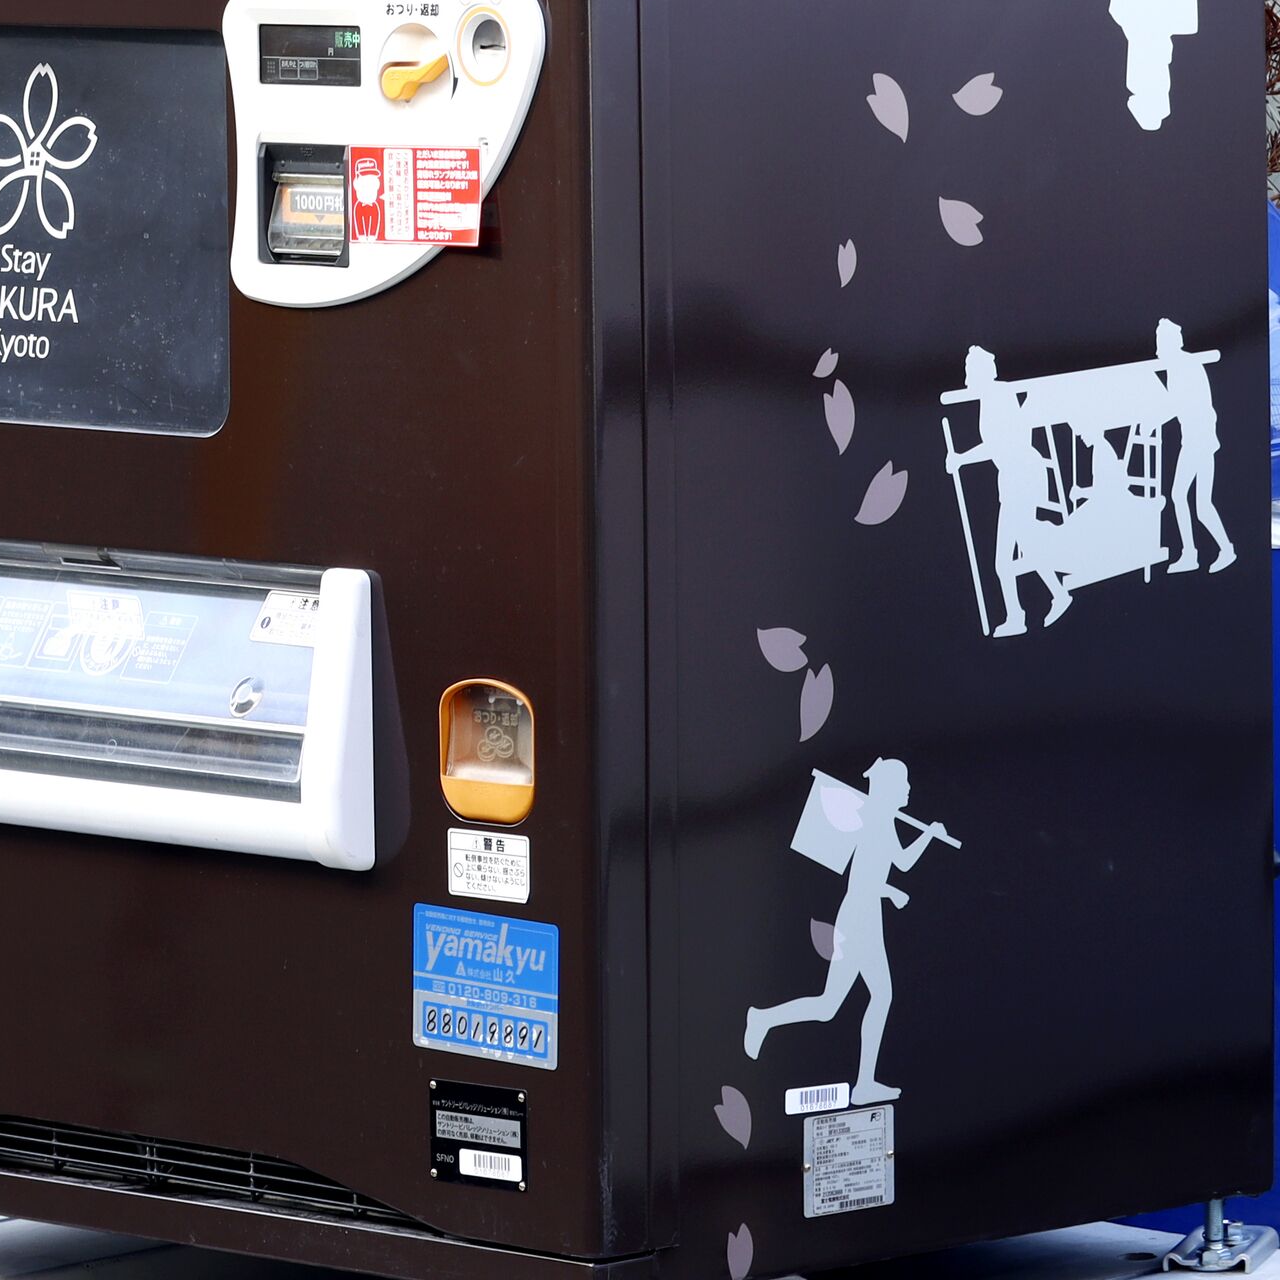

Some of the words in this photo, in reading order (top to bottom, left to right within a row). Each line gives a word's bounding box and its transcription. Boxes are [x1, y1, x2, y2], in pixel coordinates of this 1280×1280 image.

[386, 3, 440, 16] おつり・返却
[334, 31, 360, 48] 販売中
[0, 243, 52, 281] Stay
[483, 837, 506, 852] 警告
[425, 923, 546, 975] yamakyu
